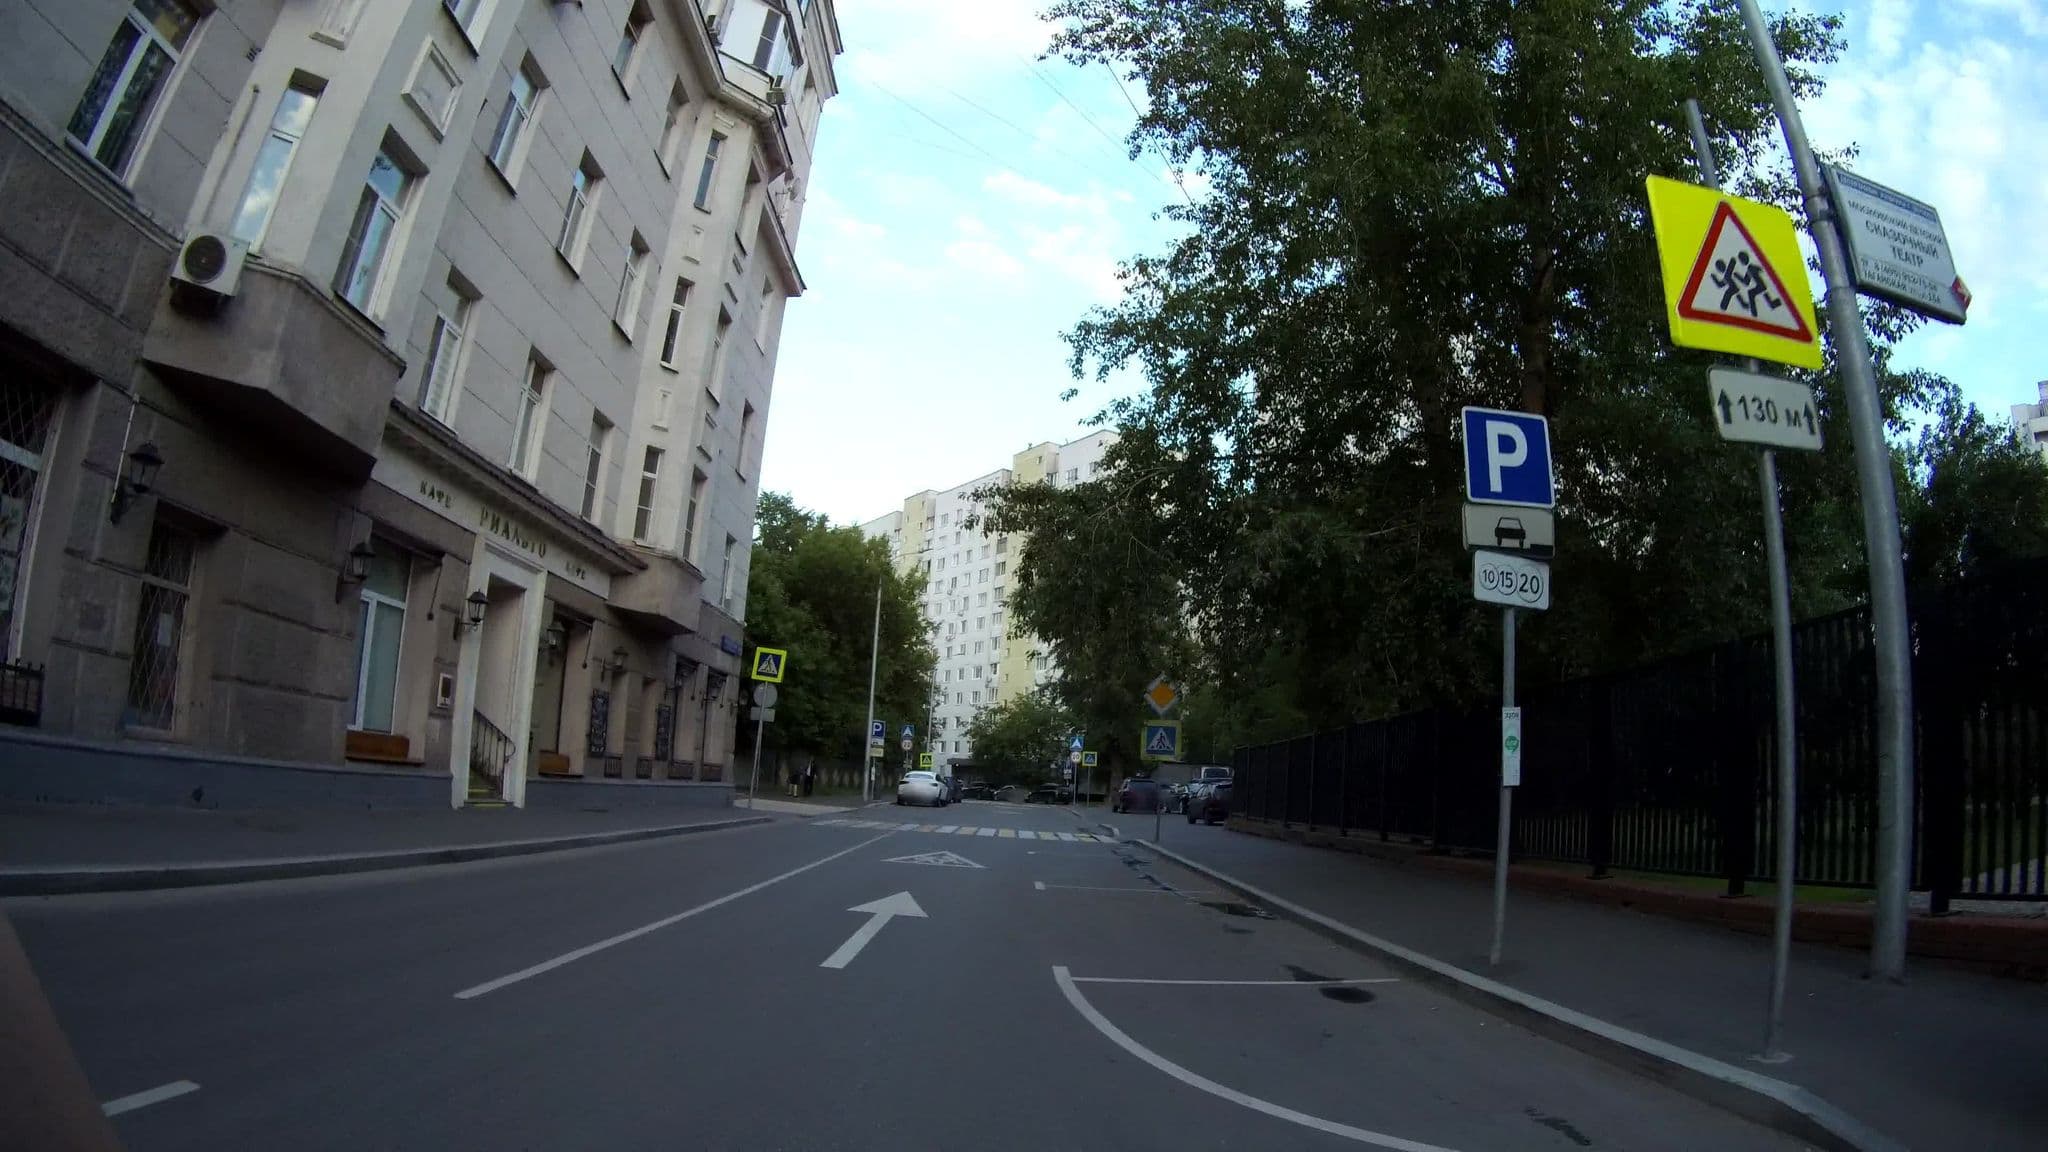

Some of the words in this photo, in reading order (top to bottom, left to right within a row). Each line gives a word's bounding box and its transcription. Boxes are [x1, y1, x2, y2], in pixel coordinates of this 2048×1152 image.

[1890, 246, 1924, 268] ТЕАТР
[1738, 394, 1778, 425] 130
[1485, 419, 1528, 493] P
[420, 480, 451, 509] КАФЕ
[480, 503, 546, 559] РИАЛЬТО
[1482, 569, 1495, 585] 10
[1499, 571, 1513, 589] 15
[1519, 573, 1540, 594] 20
[872, 722, 883, 736] P
